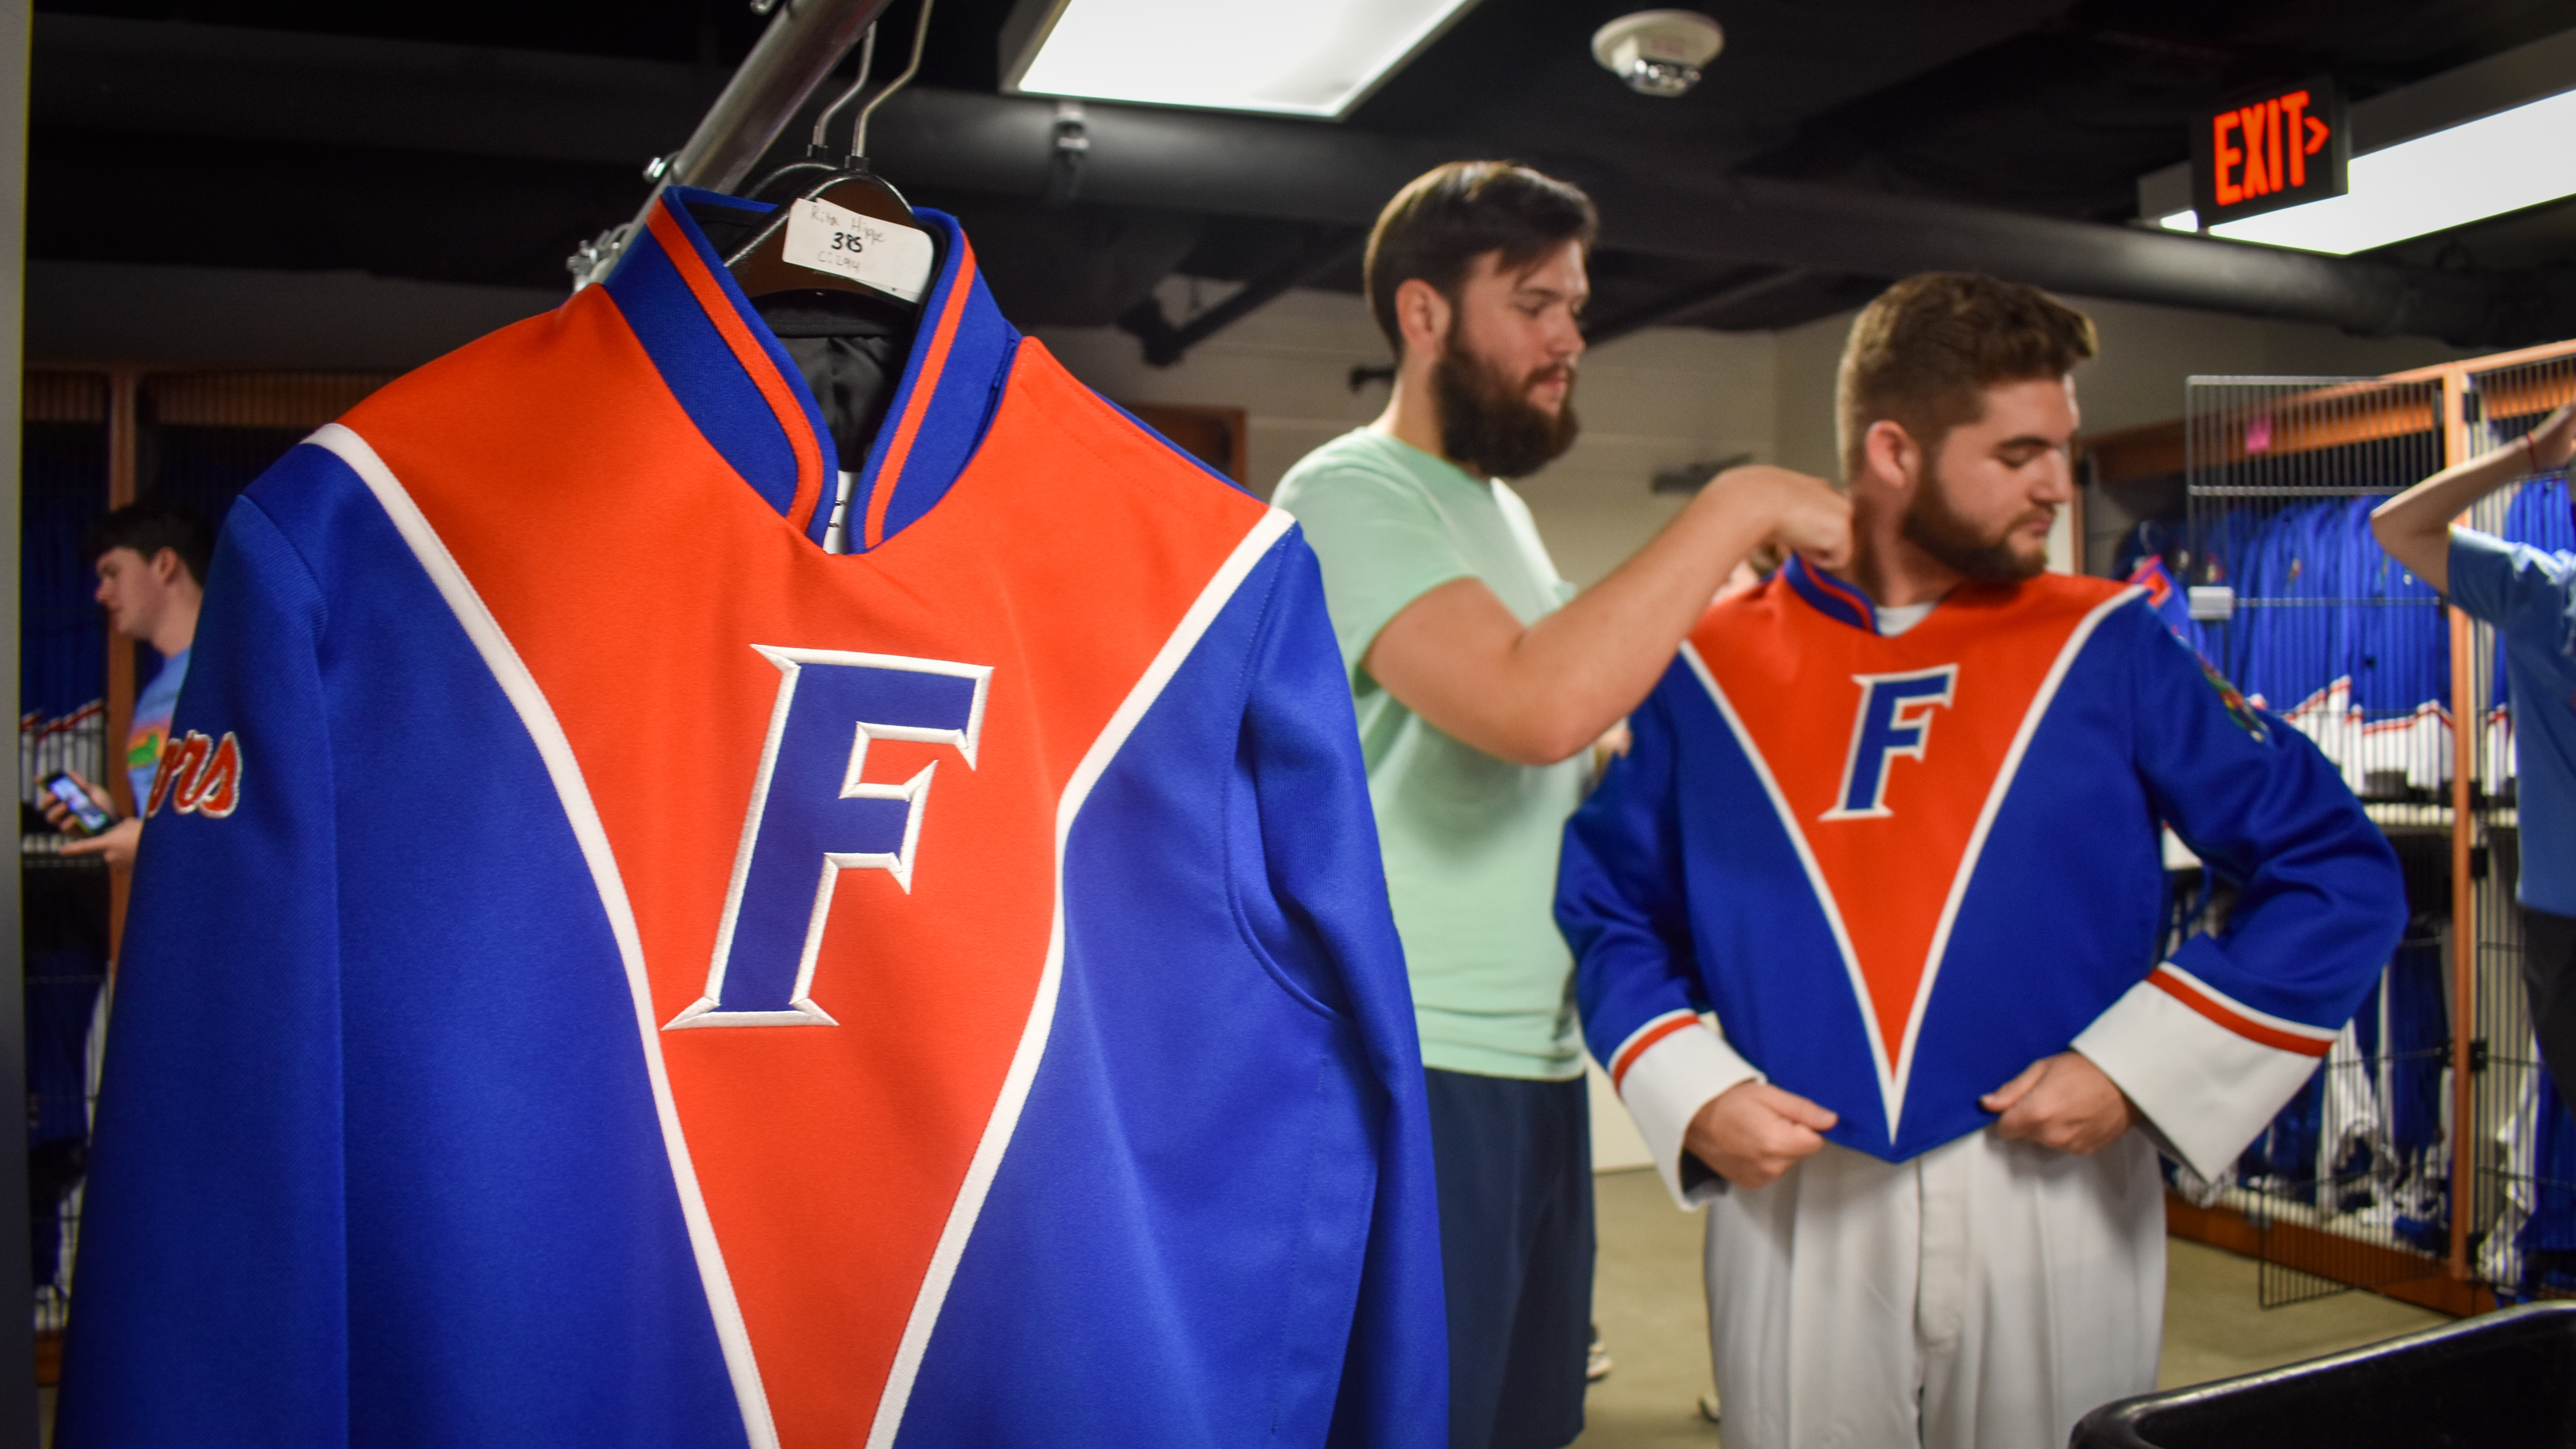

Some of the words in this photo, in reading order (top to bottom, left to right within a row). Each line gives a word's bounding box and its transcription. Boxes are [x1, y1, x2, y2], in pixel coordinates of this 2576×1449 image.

[810, 205, 840, 227] Rita
[2213, 89, 2309, 207] EXIT
[1817, 662, 1959, 823] F
[660, 644, 995, 1031] F
